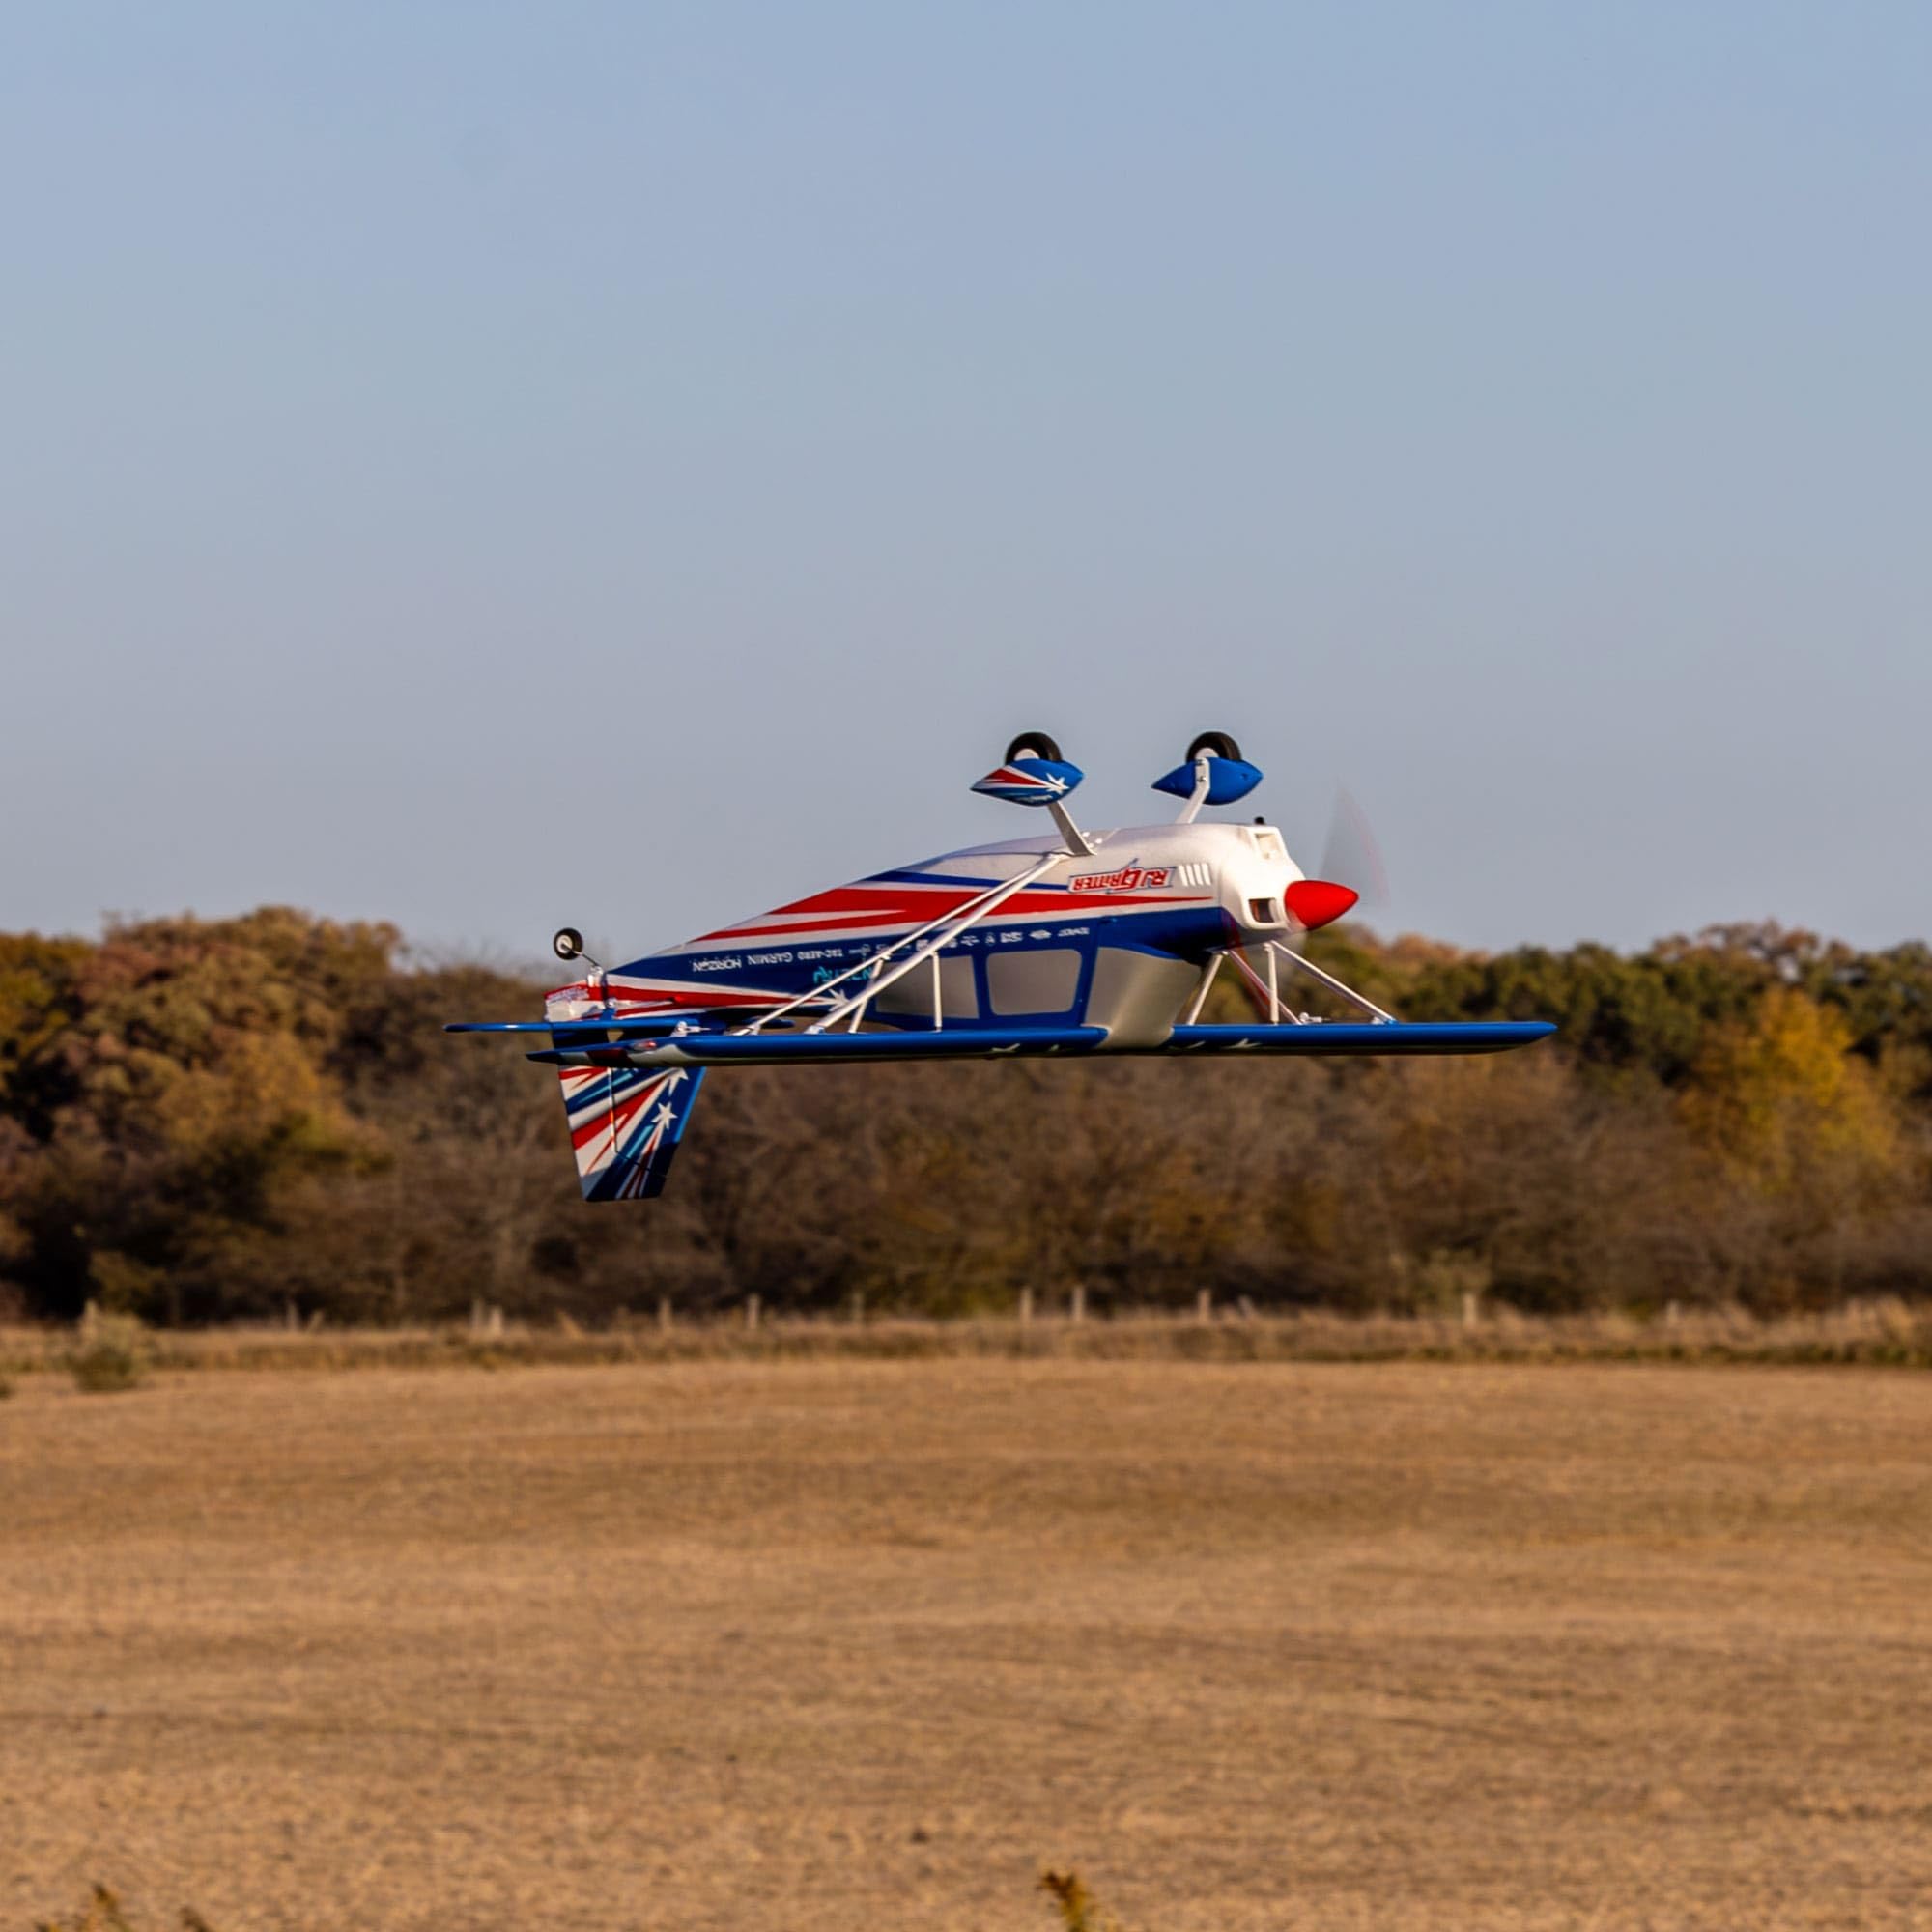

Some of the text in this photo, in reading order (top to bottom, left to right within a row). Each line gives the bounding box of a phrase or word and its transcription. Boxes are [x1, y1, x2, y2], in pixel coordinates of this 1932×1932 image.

[1140, 869, 1168, 887] RJ
[692, 958, 742, 972] HORIZON
[748, 952, 793, 965] GARMIN
